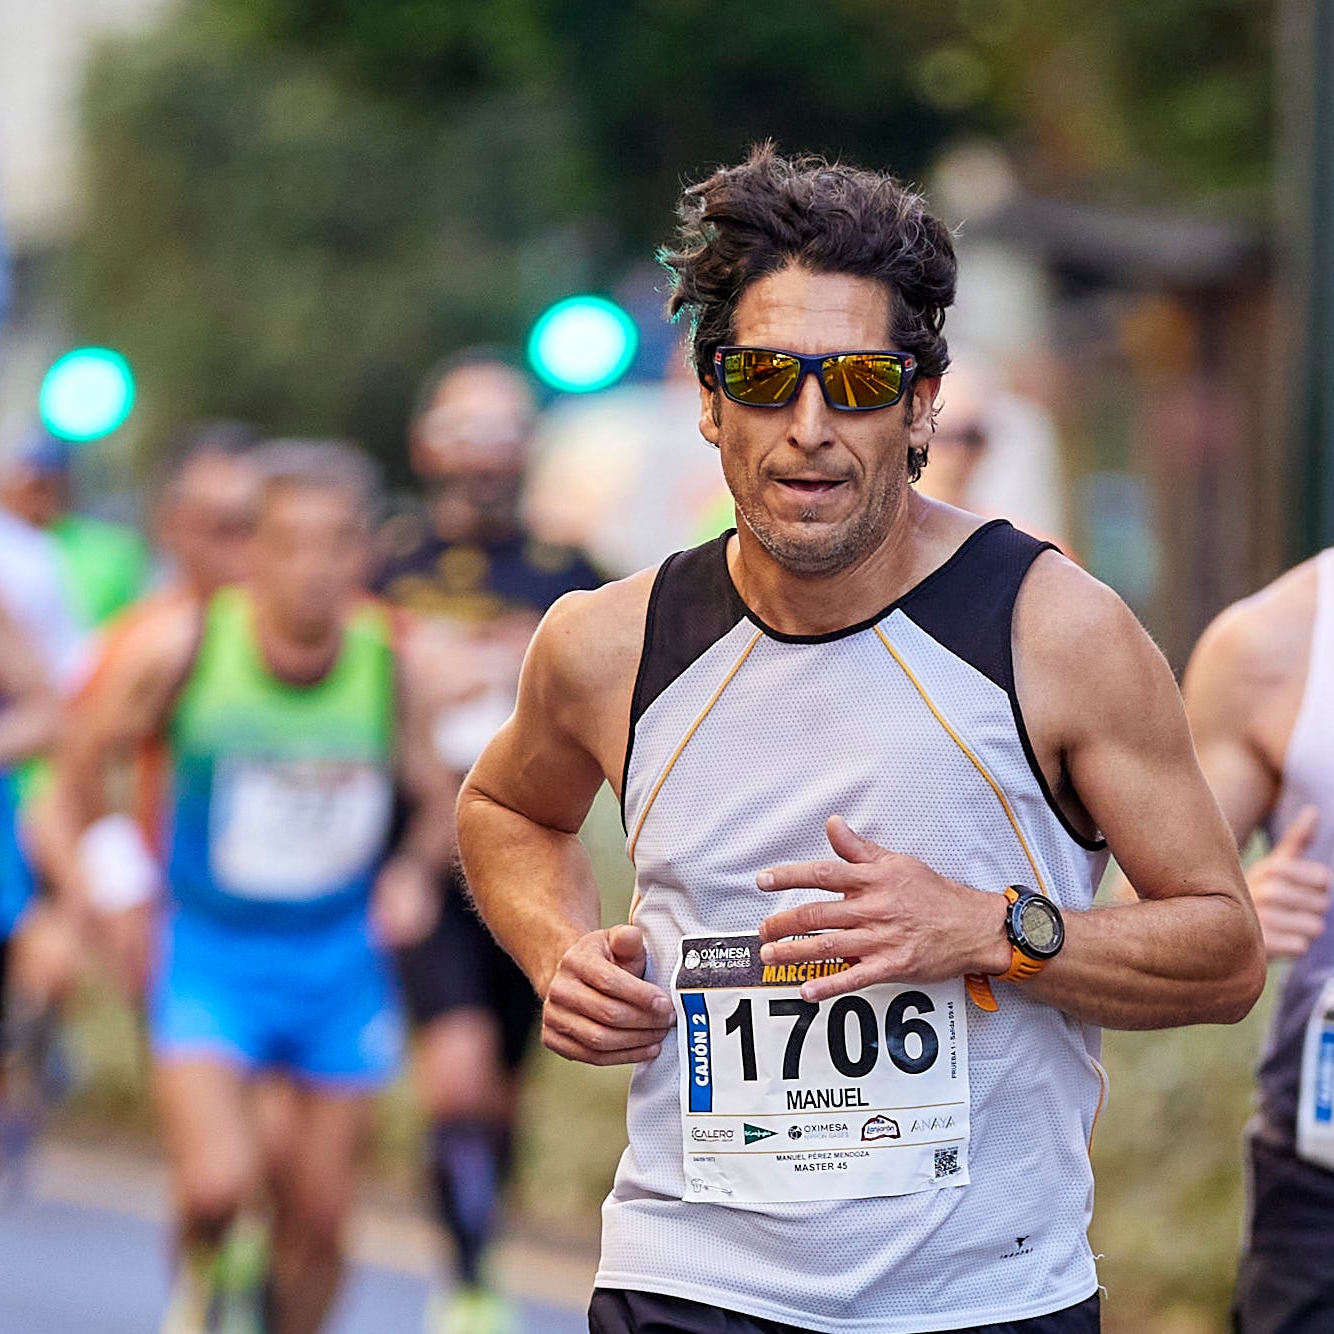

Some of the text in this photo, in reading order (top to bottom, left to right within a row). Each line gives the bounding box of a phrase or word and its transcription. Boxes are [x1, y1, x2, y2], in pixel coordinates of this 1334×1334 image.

[700, 946, 751, 960] OXIMESA
[727, 959, 751, 968] GASES
[725, 990, 939, 1082] 1706
[691, 1012, 709, 1088] CAJÓN 2
[786, 1087, 870, 1110] MANUEL
[694, 1129, 734, 1138] CALERO
[803, 1123, 849, 1133] OXIMESA
[776, 1150, 870, 1161] MANUEL PÉREZ MENDOZA
[794, 1161, 848, 1172] MASTER 45
